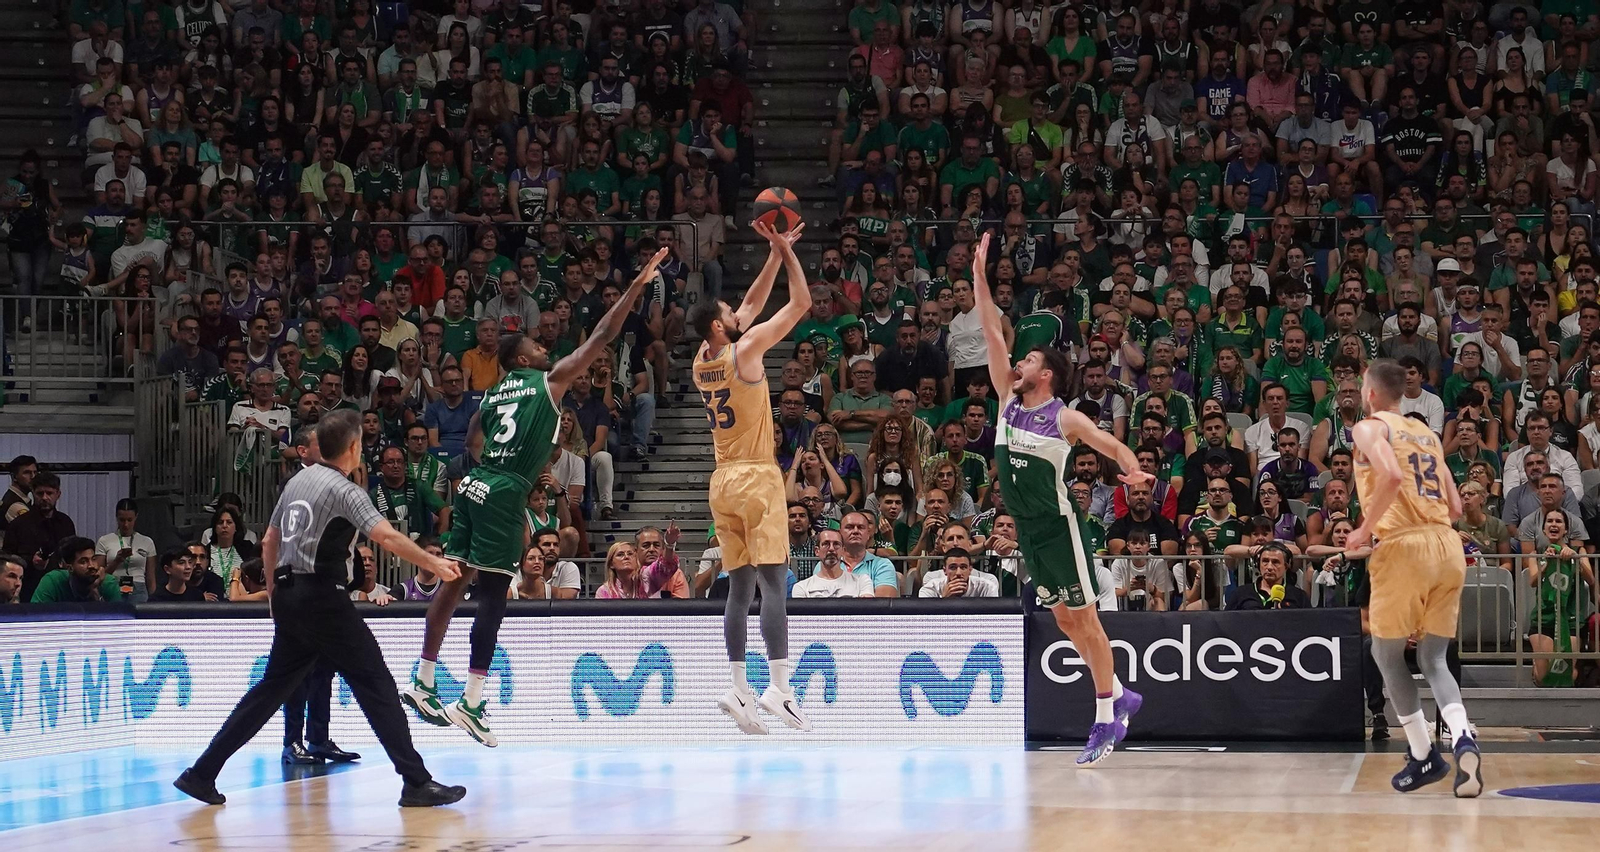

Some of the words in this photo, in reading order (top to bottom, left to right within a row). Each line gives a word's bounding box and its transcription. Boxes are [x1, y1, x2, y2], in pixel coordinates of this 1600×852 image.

[186, 20, 213, 37] CELTI
[1208, 87, 1232, 99] GAME
[1210, 105, 1227, 116] LAS
[1394, 128, 1426, 142] BOSTON
[493, 402, 519, 444] 3
[1011, 439, 1037, 450] Unicaja
[1407, 451, 1443, 500] 13
[1040, 624, 1342, 684] endesa
